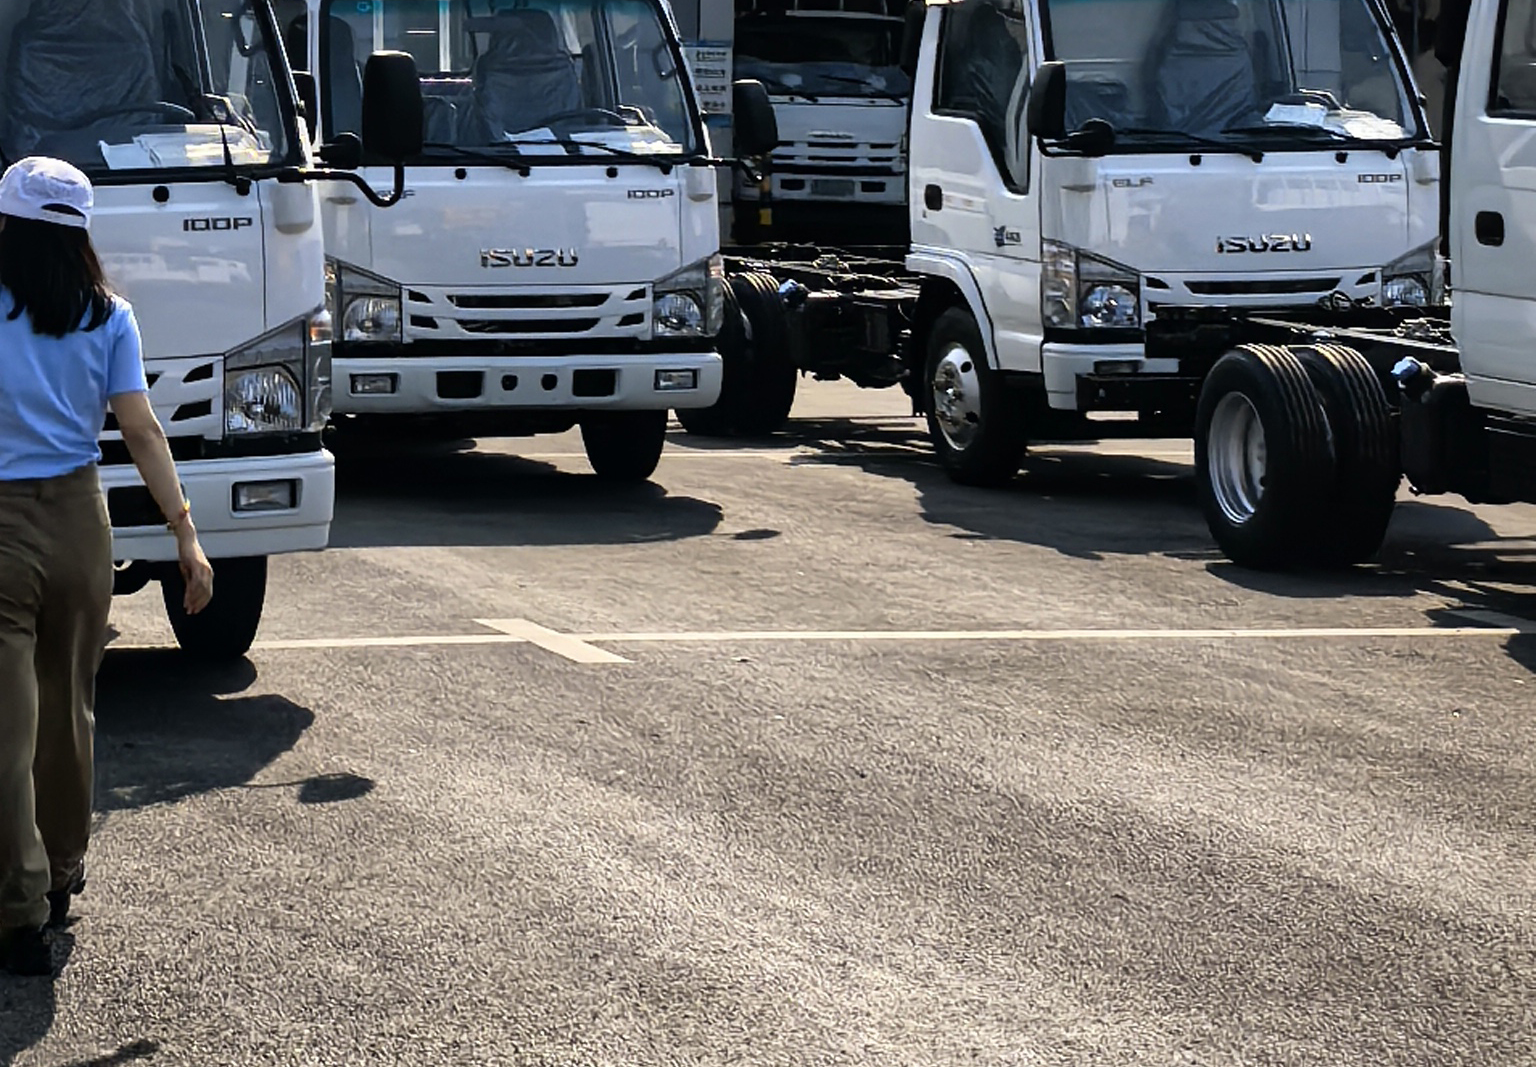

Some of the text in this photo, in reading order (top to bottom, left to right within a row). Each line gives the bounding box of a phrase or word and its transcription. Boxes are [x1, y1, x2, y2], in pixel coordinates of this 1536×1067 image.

[183, 217, 253, 232] 100P
[1215, 233, 1312, 254] ISUZU
[480, 248, 579, 268] ISUZU
